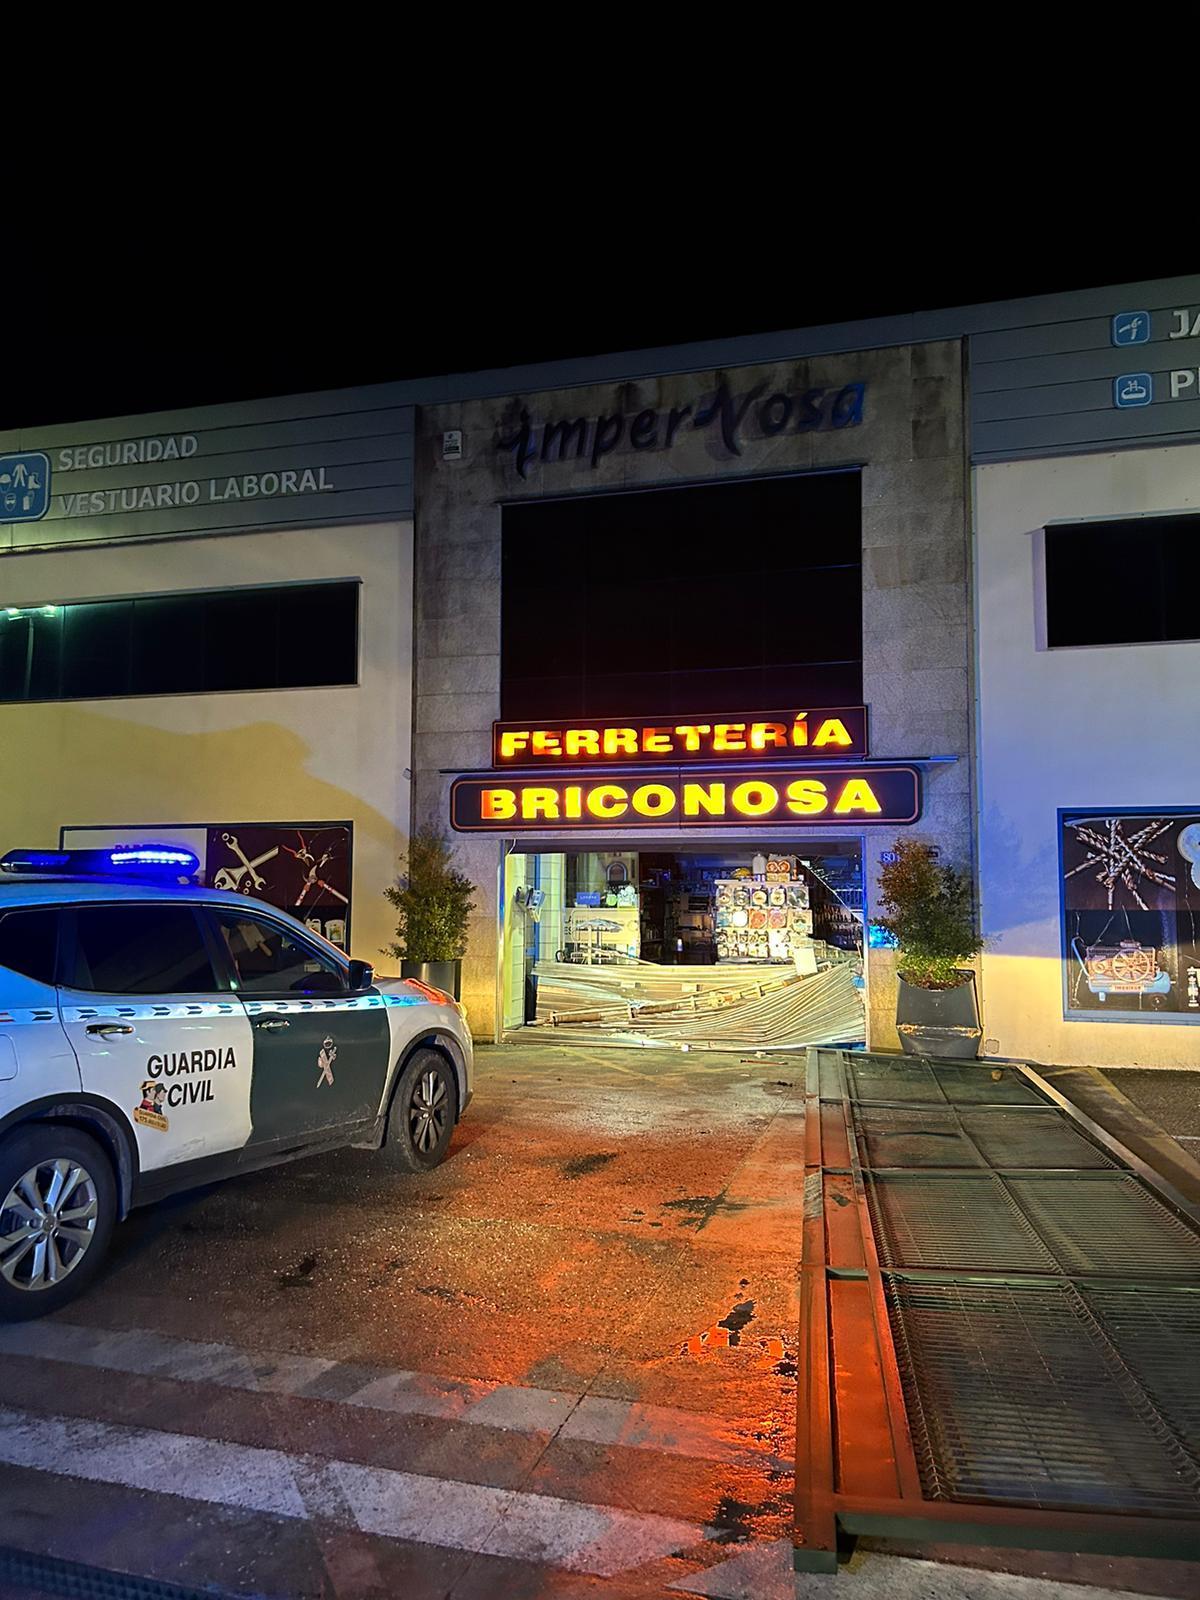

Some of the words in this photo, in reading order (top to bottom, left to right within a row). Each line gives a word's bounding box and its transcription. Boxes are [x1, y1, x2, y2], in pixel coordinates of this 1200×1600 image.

[58, 435, 198, 472] SEGURIDAD
[59, 480, 201, 516] VESTUARIO
[209, 467, 334, 503] LABORAL
[500, 712, 854, 758] FERRETERÍA
[480, 778, 883, 820] BRICONOSA
[147, 1047, 236, 1079] GUARDIA
[168, 1080, 214, 1107] CIVIL
